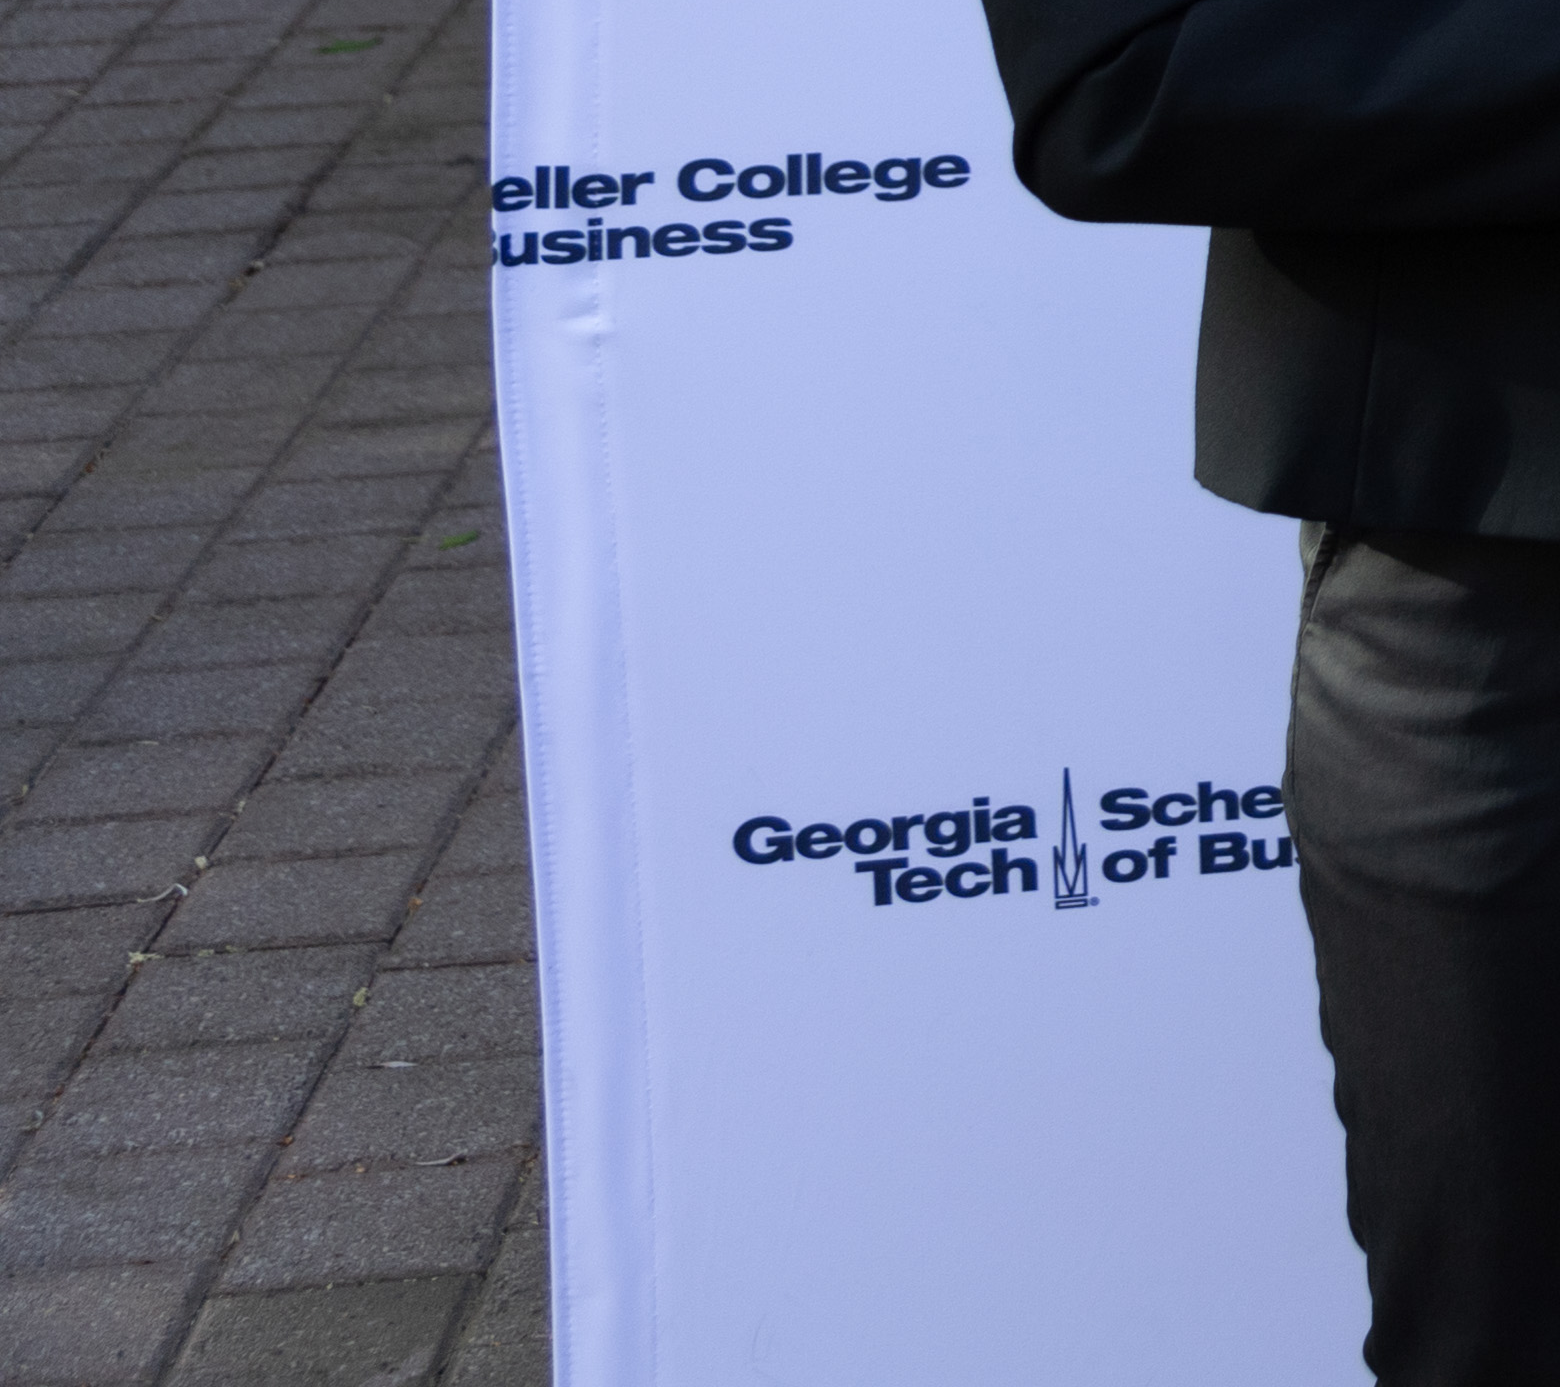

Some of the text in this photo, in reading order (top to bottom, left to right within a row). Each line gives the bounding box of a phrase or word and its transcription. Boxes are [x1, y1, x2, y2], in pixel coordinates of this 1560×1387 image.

[678, 154, 969, 201] College
[492, 215, 792, 267] usiness
[733, 797, 1036, 864] Georgia
[856, 848, 1037, 906] Tech
[1102, 837, 1176, 883] of
